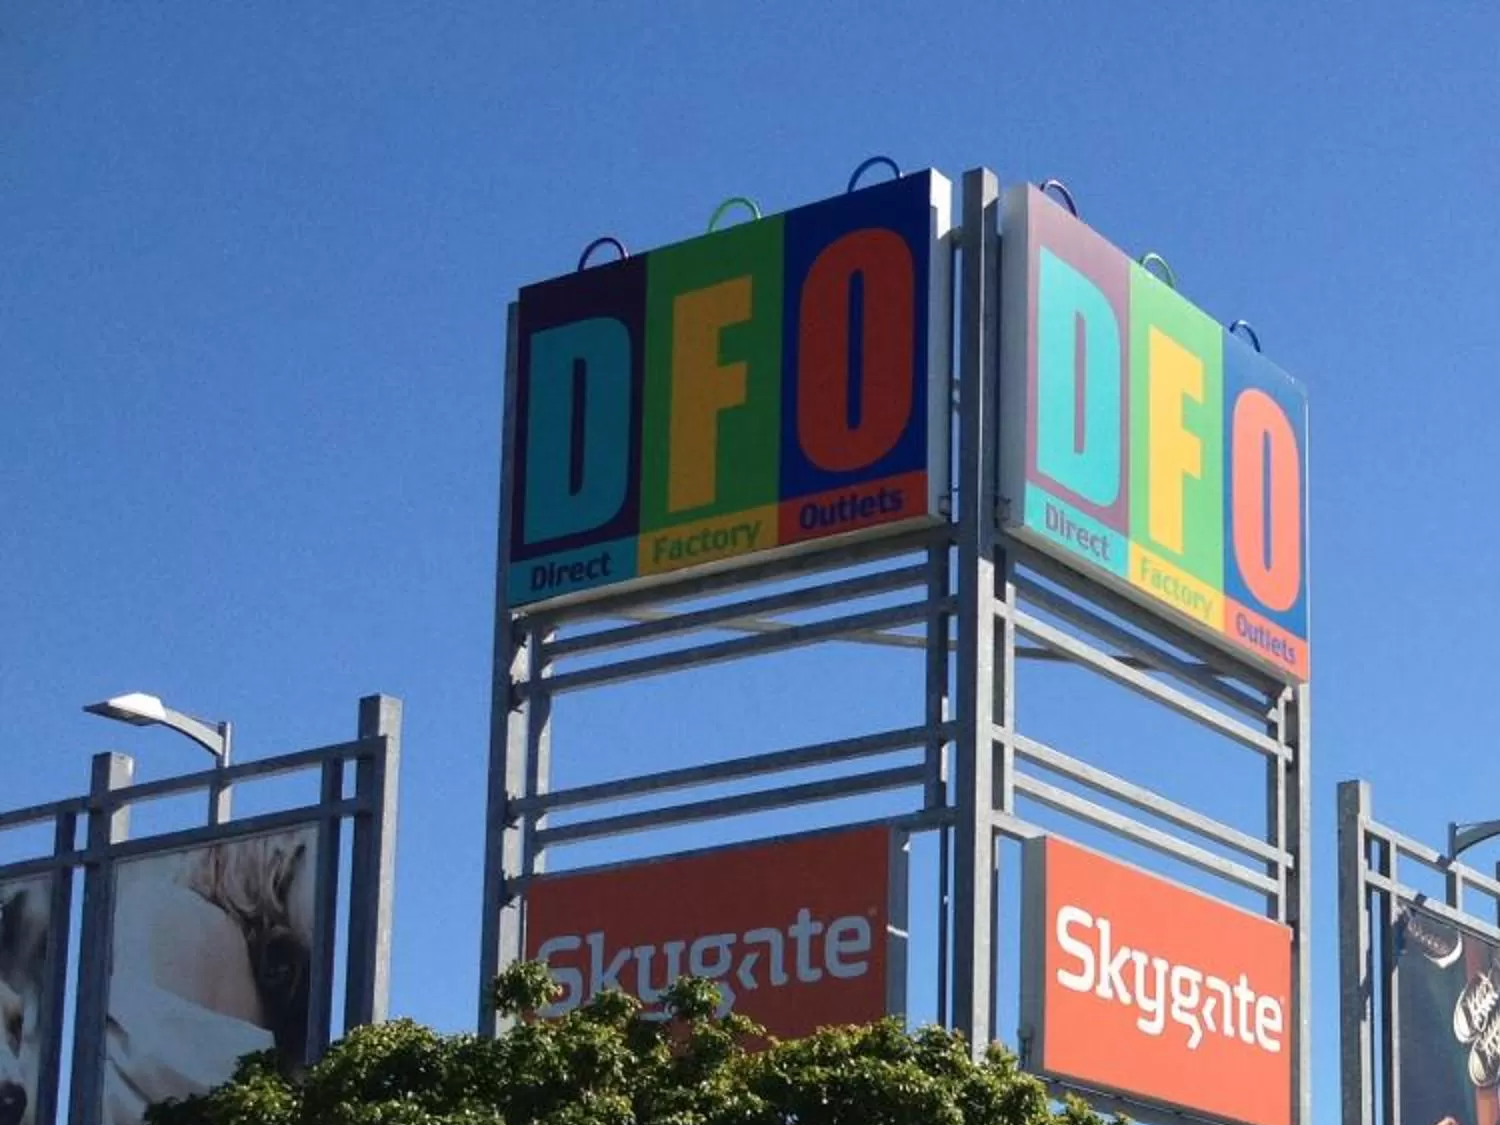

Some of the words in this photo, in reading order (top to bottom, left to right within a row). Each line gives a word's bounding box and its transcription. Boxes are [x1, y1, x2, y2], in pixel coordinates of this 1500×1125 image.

[530, 551, 611, 592] Direct
[652, 520, 764, 565] Factory
[800, 488, 904, 531] Outlets
[1043, 502, 1111, 562] Direct
[1140, 556, 1215, 616] Factory
[1235, 612, 1297, 666] Outlets
[536, 907, 872, 1021] Skygate
[1056, 904, 1284, 1050] Skygate
